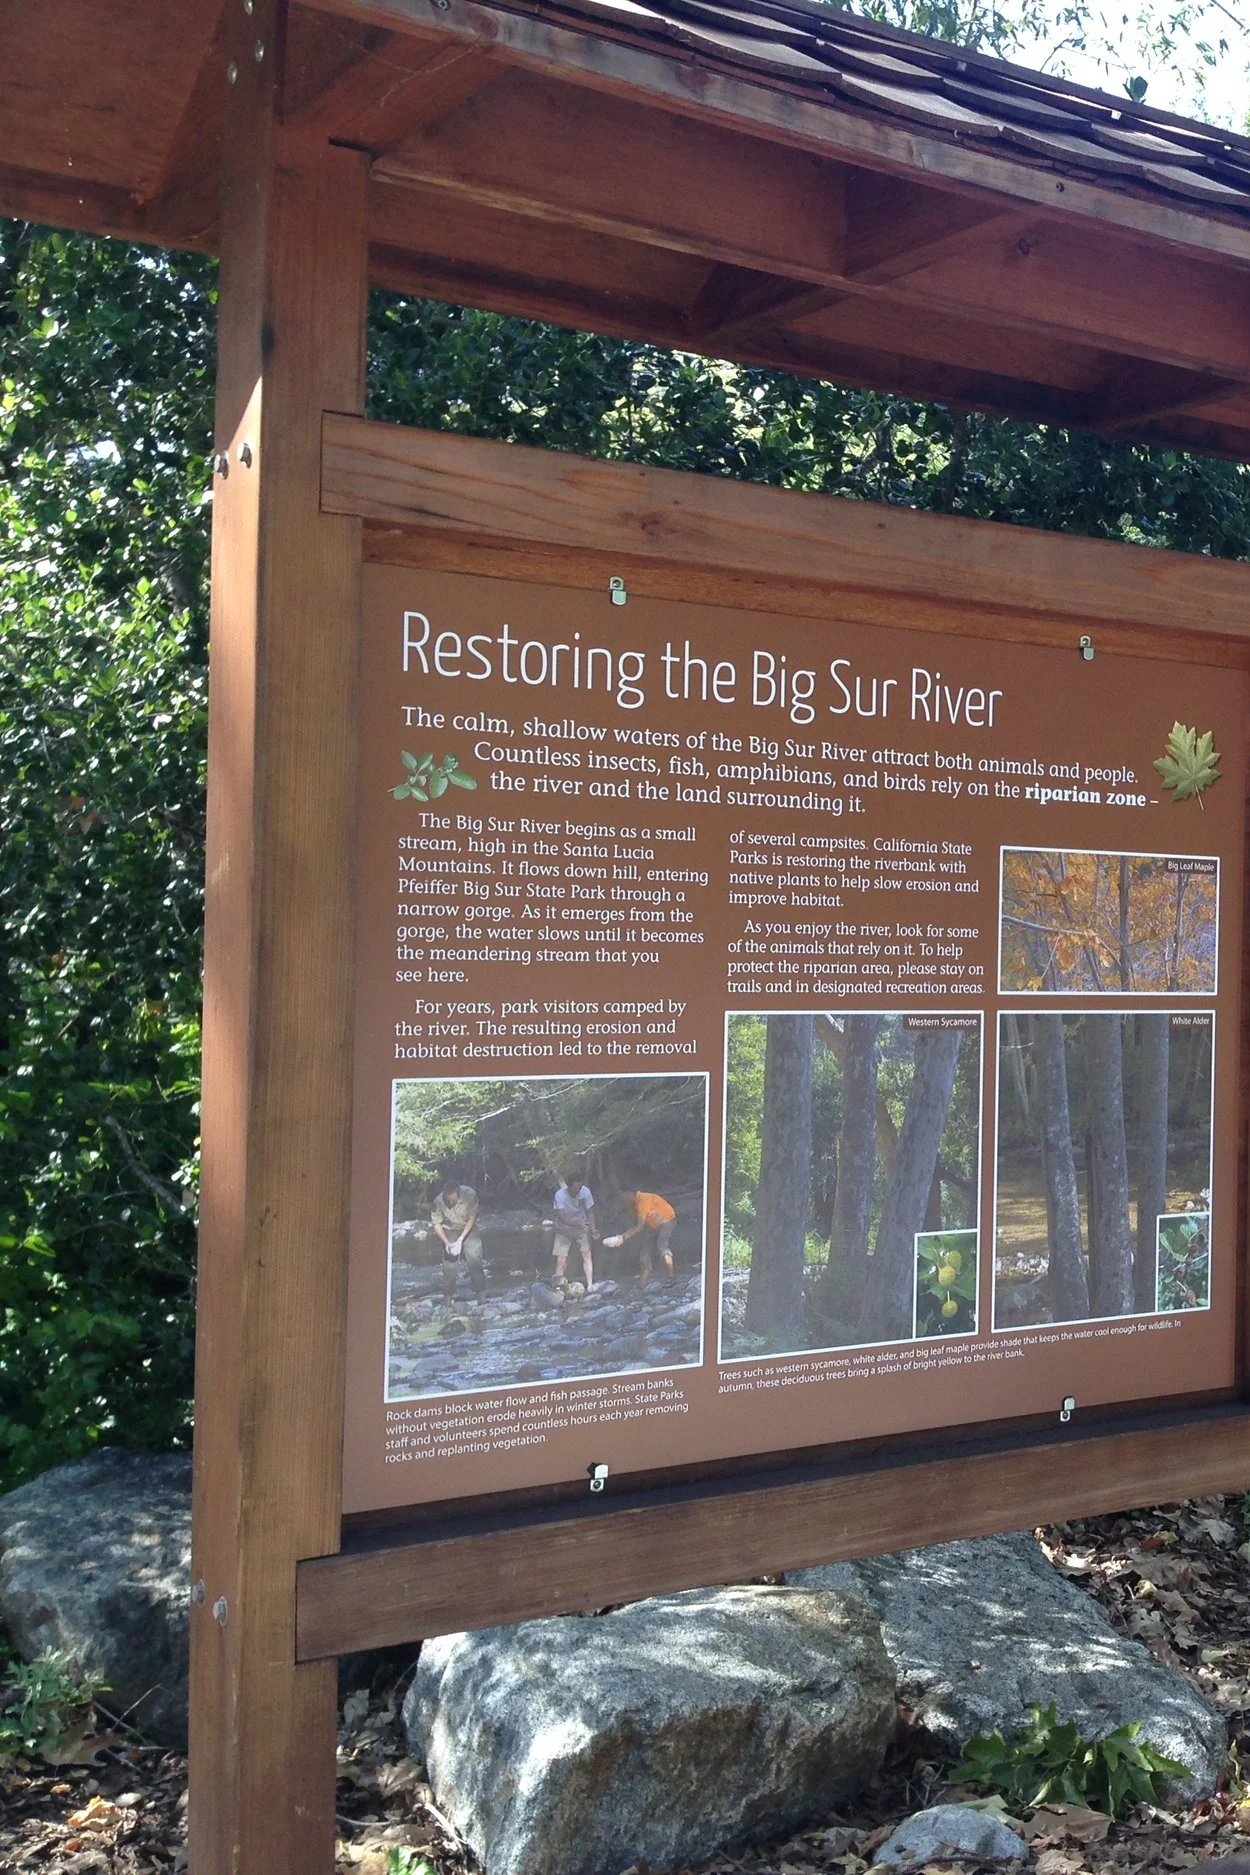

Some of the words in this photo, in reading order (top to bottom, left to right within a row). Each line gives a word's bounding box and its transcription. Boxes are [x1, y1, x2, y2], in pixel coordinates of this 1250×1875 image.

[403, 611, 645, 709] Restoring
[660, 640, 736, 703] the
[753, 650, 816, 725] Big
[829, 659, 898, 717] Sur
[911, 668, 1003, 727] River
[401, 706, 445, 729] The
[523, 716, 607, 741] shallow
[613, 728, 680, 748] waters
[686, 731, 707, 749] of
[711, 732, 742, 752] the
[749, 735, 778, 761] Big
[784, 738, 816, 758] Sur
[821, 741, 867, 762] River
[871, 748, 930, 767] attract
[934, 750, 973, 771] both
[978, 757, 1044, 776] animals
[1049, 762, 1080, 779] and
[474, 741, 581, 767] Countless
[843, 770, 878, 788] and
[883, 771, 926, 792] birds
[931, 776, 963, 799] rely
[967, 782, 989, 796] on
[994, 780, 1020, 798] the
[1025, 782, 1101, 805] riparian
[1106, 792, 1146, 807] zone
[490, 770, 525, 791] the
[533, 774, 583, 795] river
[589, 779, 630, 798] and
[636, 780, 669, 800] the
[676, 782, 721, 804] land
[727, 791, 842, 817] surrounding
[418, 812, 451, 829] The
[456, 814, 483, 835] Big
[487, 816, 515, 832] Sur
[520, 818, 561, 834] River
[565, 820, 616, 840] begins
[620, 827, 637, 838] as
[641, 828, 651, 839] a
[655, 826, 696, 841] small
[730, 830, 745, 844] of
[747, 832, 796, 846] several
[873, 837, 938, 854] California
[941, 841, 972, 855] State
[502, 860, 514, 875] It
[519, 861, 560, 877] flows
[564, 863, 607, 879] down
[647, 868, 708, 886] entering
[1168, 860, 1178, 871] Big
[1179, 861, 1193, 870] Leaf
[1194, 862, 1214, 872] Maple
[729, 890, 787, 908] improve
[415, 999, 443, 1014] For
[501, 998, 539, 1018] park
[543, 999, 599, 1014] visitors
[603, 998, 664, 1017] camped
[668, 999, 687, 1017] by
[1172, 1016, 1191, 1025] White
[1192, 1017, 1210, 1025] Alder
[908, 1017, 940, 1026] Western
[941, 1017, 977, 1028] Sycamore
[756, 1379, 780, 1389] these
[781, 1373, 825, 1386] deciduous
[826, 1371, 846, 1380] trees
[847, 1367, 869, 1378] bring
[870, 1367, 876, 1375] a
[877, 1362, 902, 1375] splash
[903, 1361, 912, 1371] of
[913, 1358, 937, 1370] bright
[937, 1356, 963, 1368] yellow
[963, 1355, 972, 1363] to
[973, 1353, 986, 1362] the
[987, 1351, 1004, 1360] river
[386, 1409, 412, 1422] Rock
[414, 1407, 443, 1418] dams
[445, 1401, 473, 1414] block
[475, 1400, 504, 1410] water
[505, 1396, 527, 1407] flow
[529, 1391, 548, 1404] and
[550, 1390, 568, 1401] fish
[612, 1382, 645, 1394] Stream
[647, 1377, 674, 1390] banks
[385, 1451, 413, 1463] rocks
[414, 1447, 435, 1460] and
[437, 1442, 490, 1457] replanting
